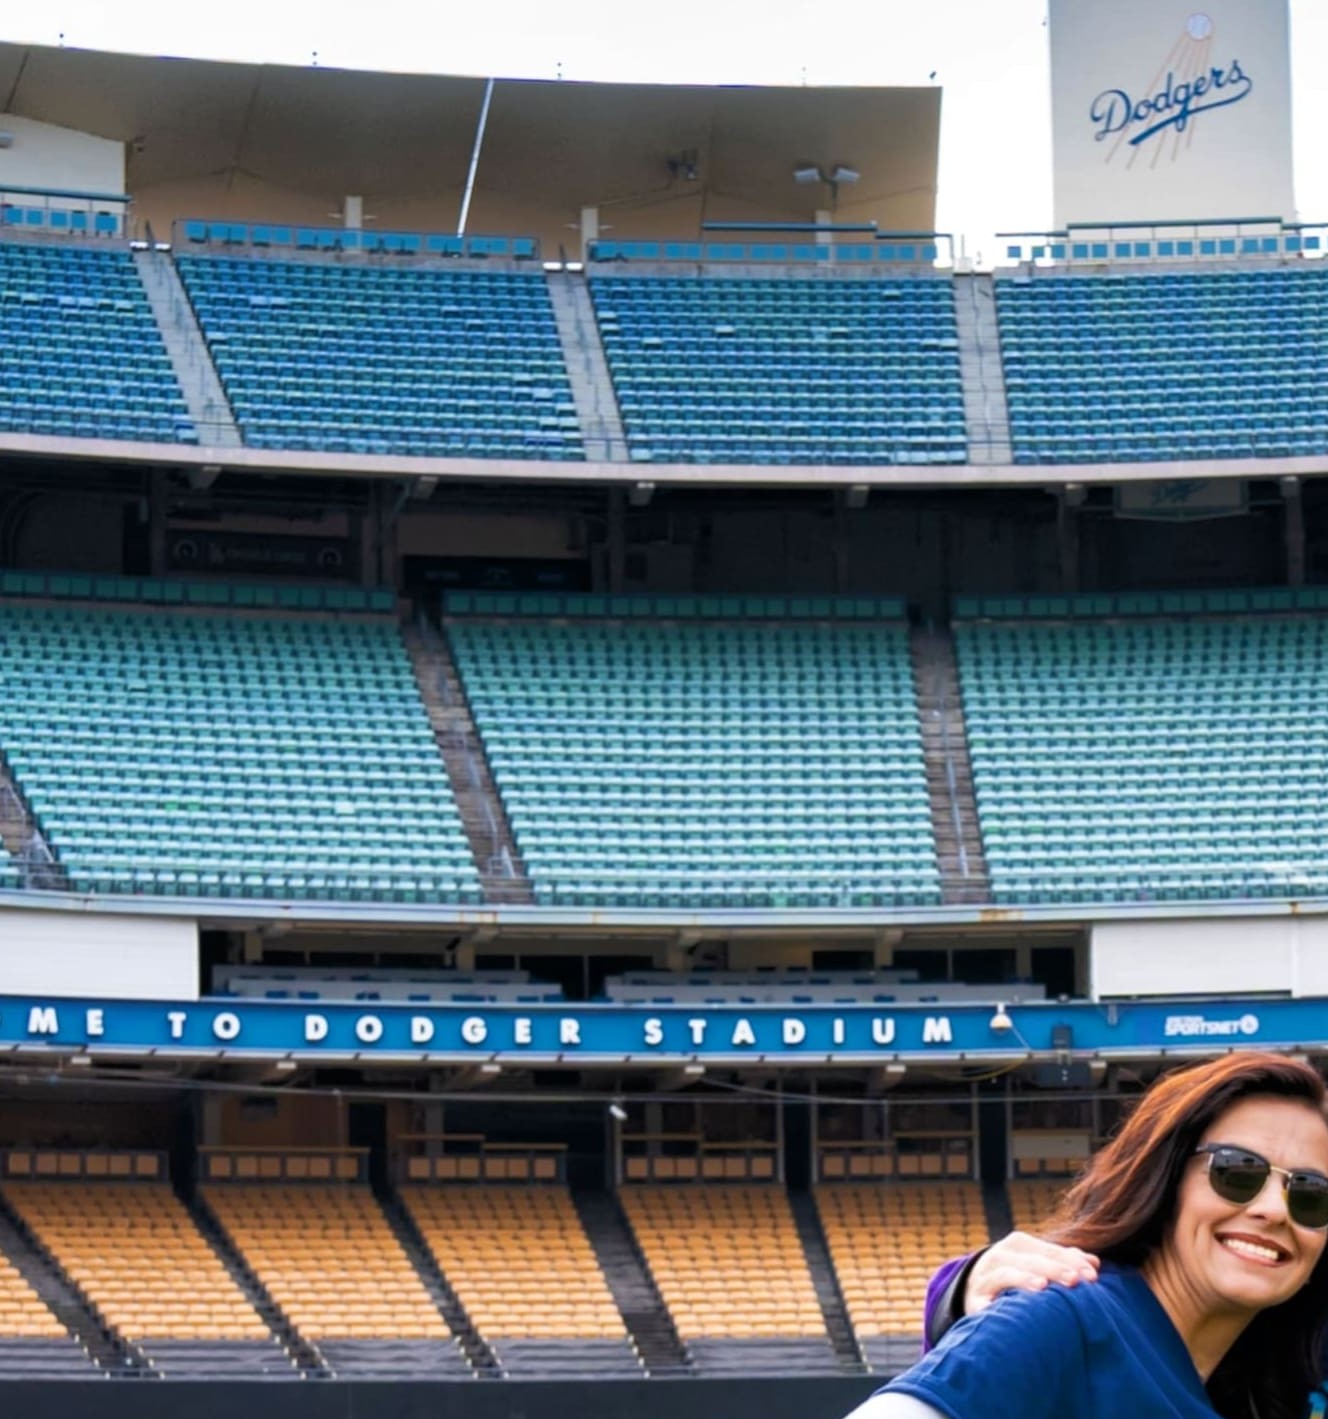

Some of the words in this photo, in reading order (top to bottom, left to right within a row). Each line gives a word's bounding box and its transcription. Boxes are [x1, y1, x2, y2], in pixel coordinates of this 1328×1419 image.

[1091, 60, 1252, 146] Dodgers
[27, 1006, 104, 1037] ME
[167, 1012, 241, 1041] TO
[304, 1013, 579, 1045] DODGER
[644, 1016, 954, 1046] STADIUM
